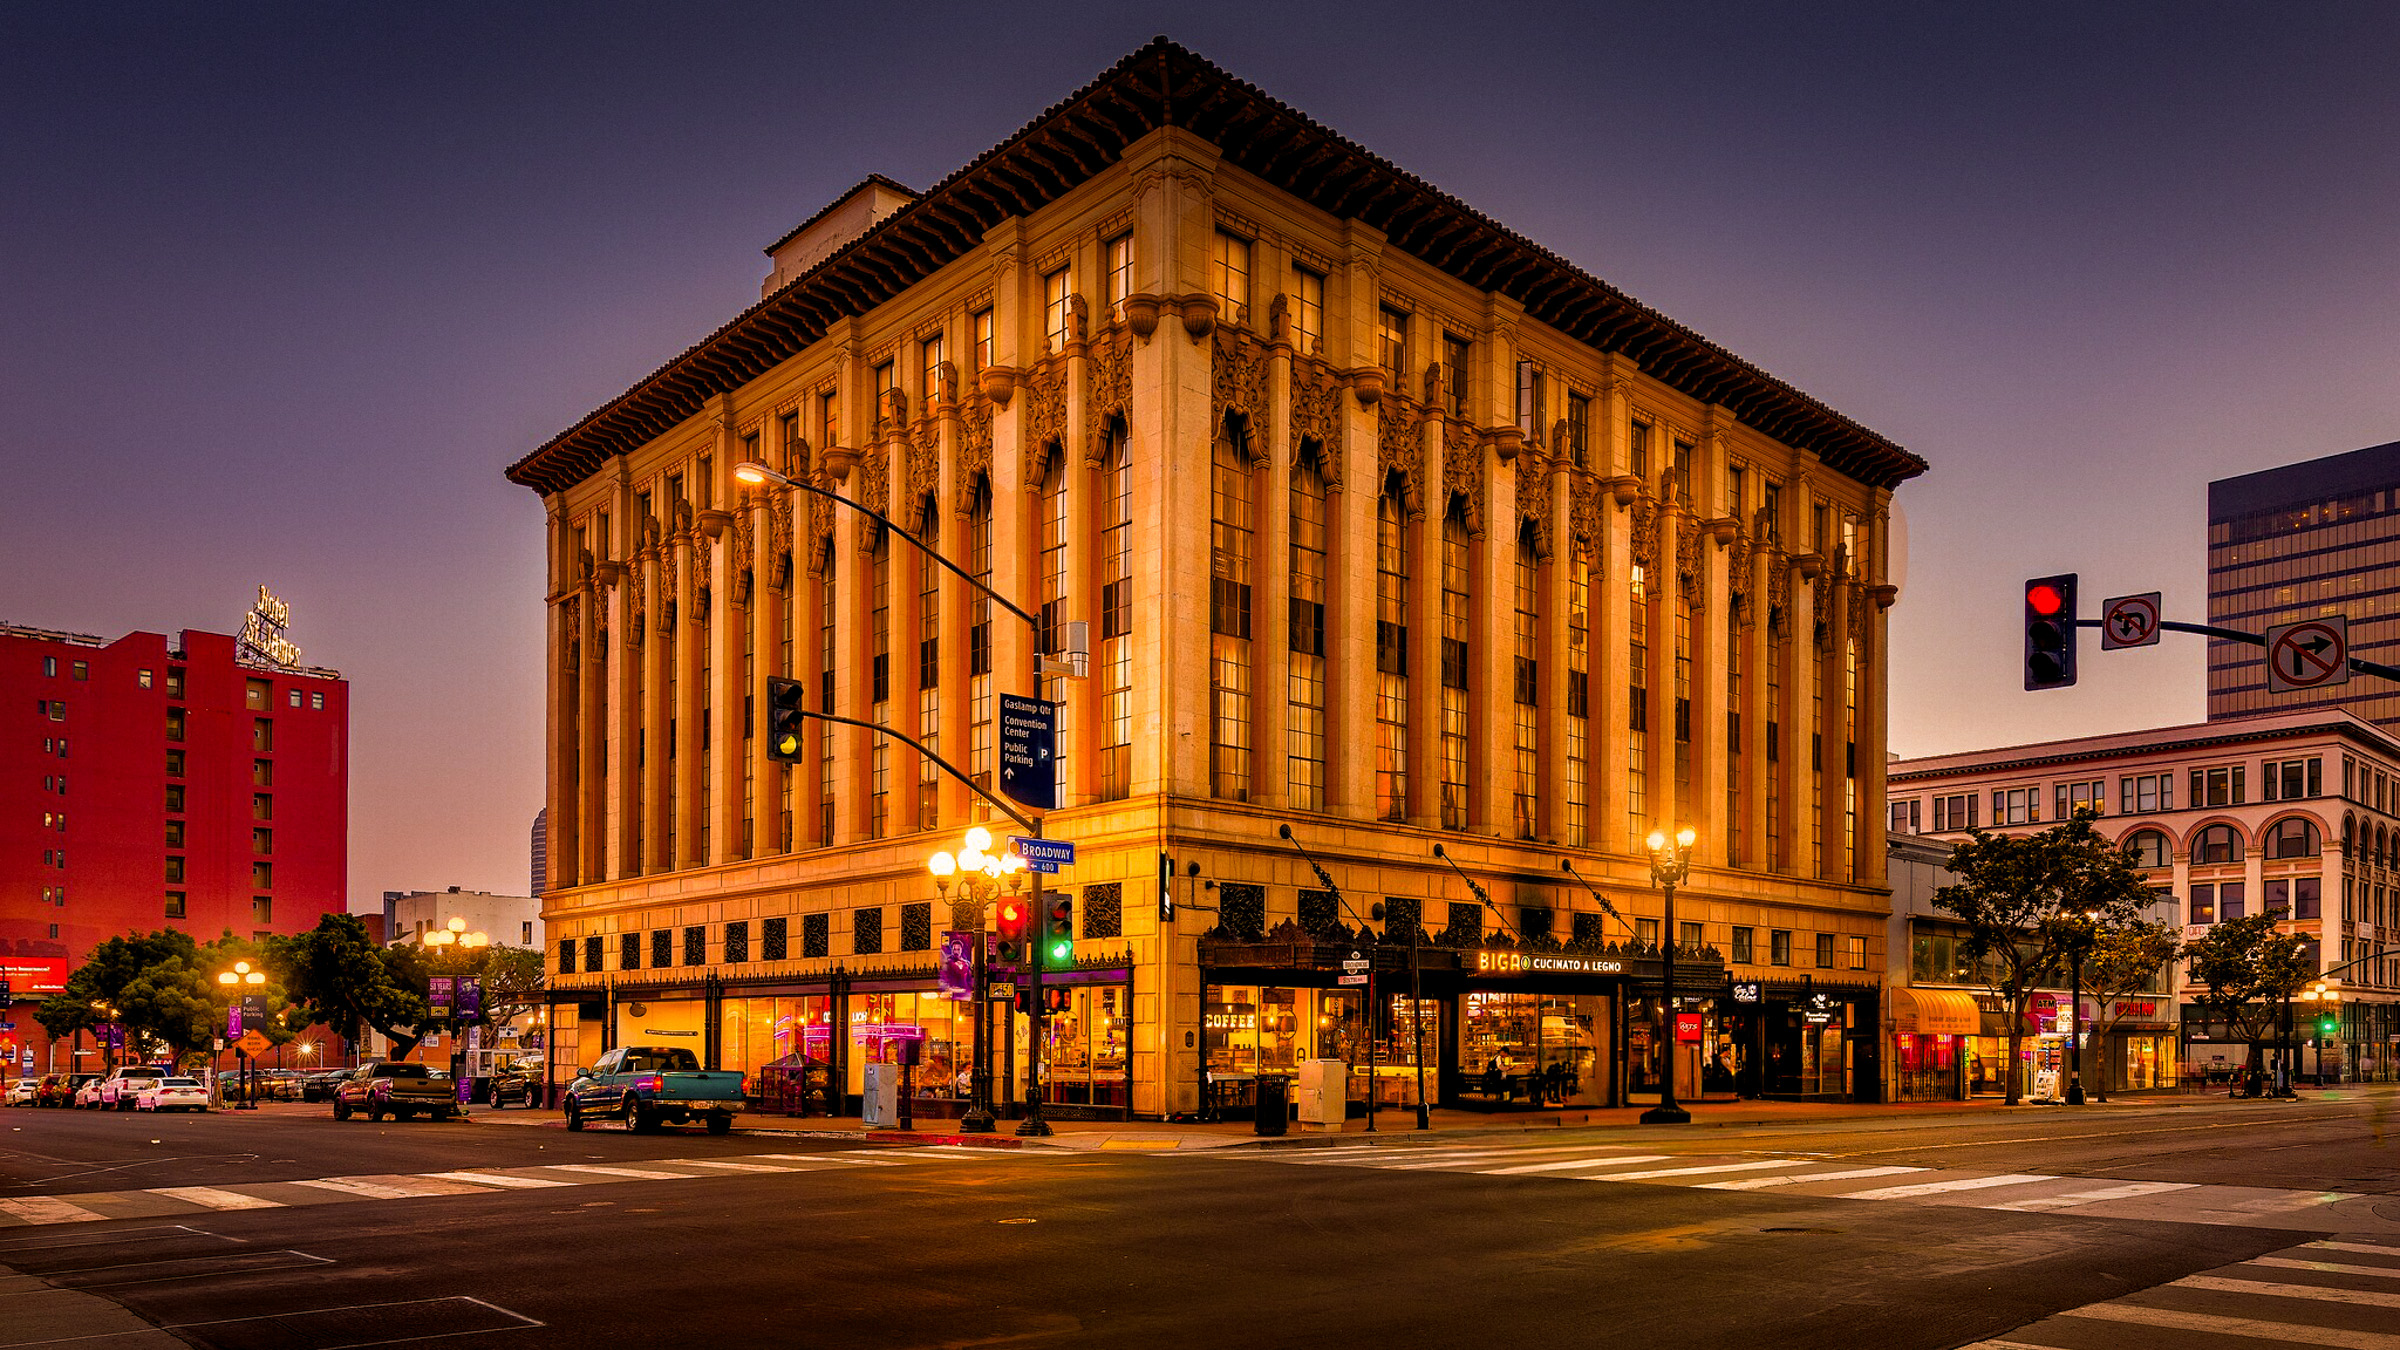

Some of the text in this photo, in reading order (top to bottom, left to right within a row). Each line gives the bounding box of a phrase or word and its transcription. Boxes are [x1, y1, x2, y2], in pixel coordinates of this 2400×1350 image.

[257, 584, 289, 628] Hotel
[263, 623, 301, 668] James
[1004, 699, 1051, 715] Gaslamp Qtr
[1004, 715, 1047, 730] Convention
[1004, 726, 1030, 738] Center
[1004, 742, 1048, 759] Public P
[1004, 752, 1033, 767] Parking
[1022, 842, 1071, 860] BROADWAY
[1041, 862, 1055, 871] 600
[1480, 952, 1521, 971] BIGA
[1533, 958, 1622, 972] CUCINATO A LEGNO
[245, 996, 252, 1004] P
[2037, 999, 2056, 1009] ATM
[1206, 1014, 1255, 1028] COFFEE
